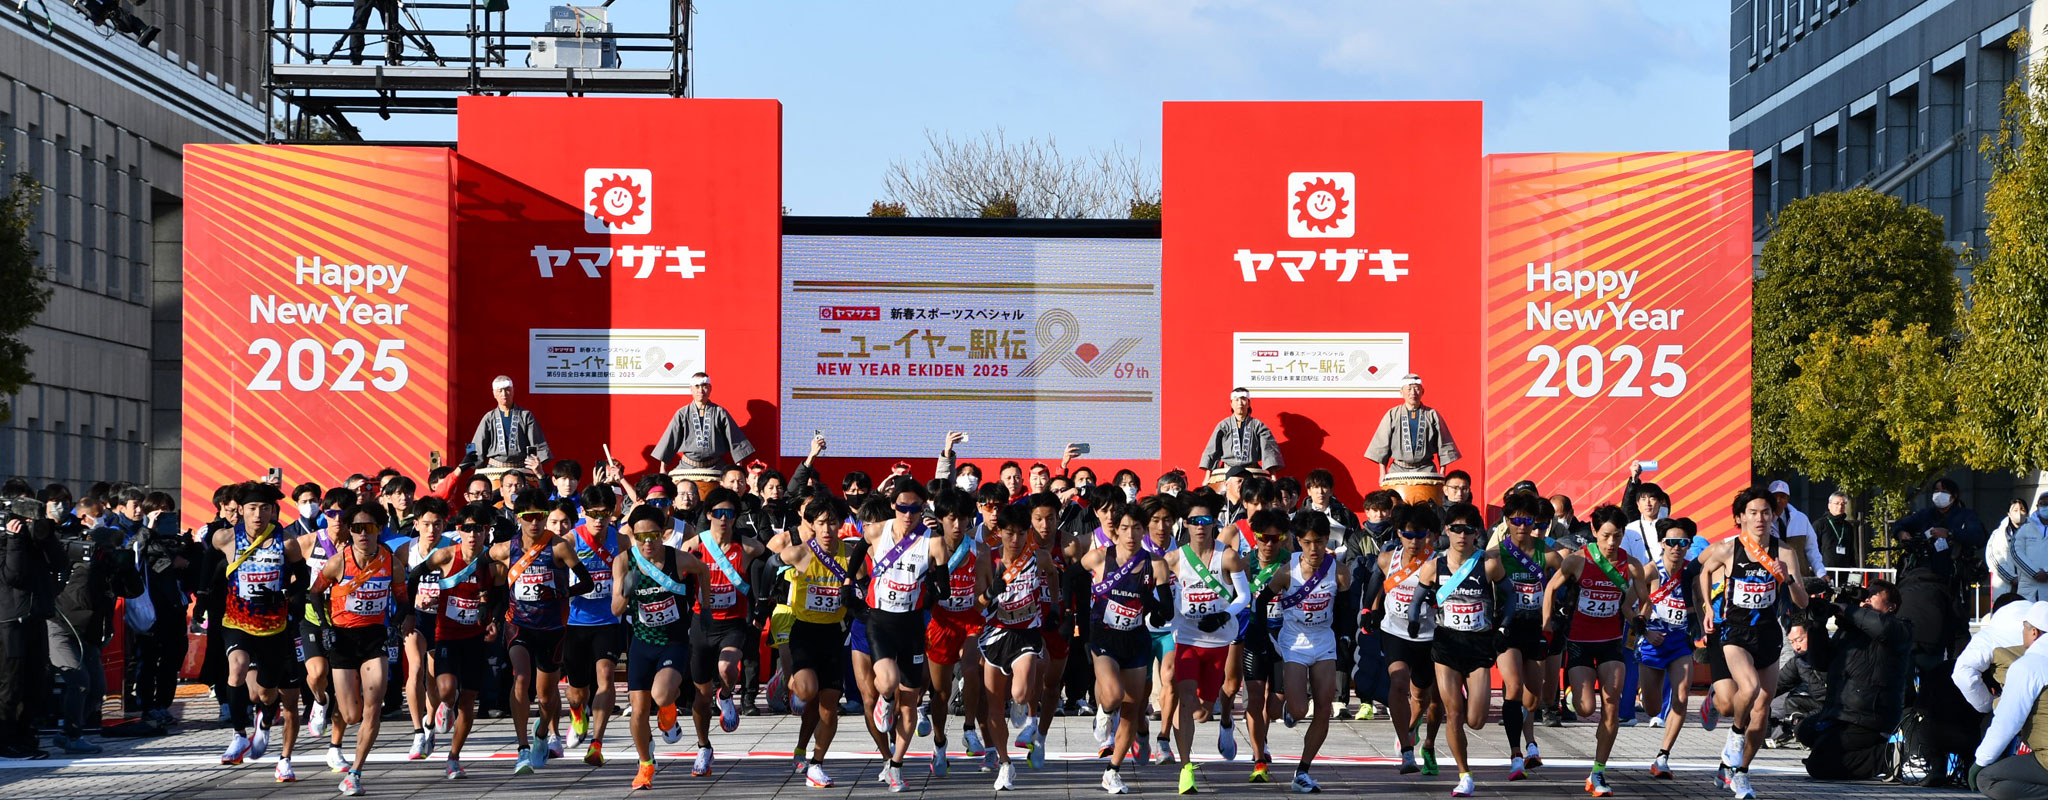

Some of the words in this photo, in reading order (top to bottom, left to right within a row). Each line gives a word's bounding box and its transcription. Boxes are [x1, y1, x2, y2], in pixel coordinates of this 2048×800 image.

[531, 246, 705, 279] ヤマザキ
[1234, 249, 1409, 282] ヤマザキ
[295, 256, 408, 294] Happy
[1527, 263, 1639, 300] Happy
[250, 295, 335, 324] New
[333, 296, 408, 324] Year
[834, 308, 879, 319] ヤマザキ
[891, 307, 1024, 321] 新春スポーツスペシャル
[1527, 302, 1605, 331] New
[1605, 302, 1684, 331] Year
[817, 328, 1027, 360] ニューイヤー駅伝
[246, 338, 409, 391] 2025
[546, 356, 642, 370] ニューイヤー駅伝
[817, 363, 852, 377] NEW
[859, 363, 900, 377] YEAR
[908, 363, 965, 377] EKIDEN
[973, 364, 1008, 377] 2025
[1251, 359, 1346, 373] ニューイヤー駅伝
[1114, 363, 1149, 379] 69th
[1525, 345, 1688, 398] 2025
[594, 582, 611, 593] 0-1
[888, 591, 912, 601] 8-1
[949, 596, 973, 607] 12-1
[1742, 593, 1772, 604] 20-1
[354, 601, 383, 611] 28-1
[1189, 603, 1216, 615] 36-1
[1587, 601, 1616, 612] 24-1
[645, 609, 674, 622] 23-1
[1010, 607, 1031, 620] 1-1
[1304, 612, 1328, 623] 2-1
[1452, 614, 1480, 626] 34-1
